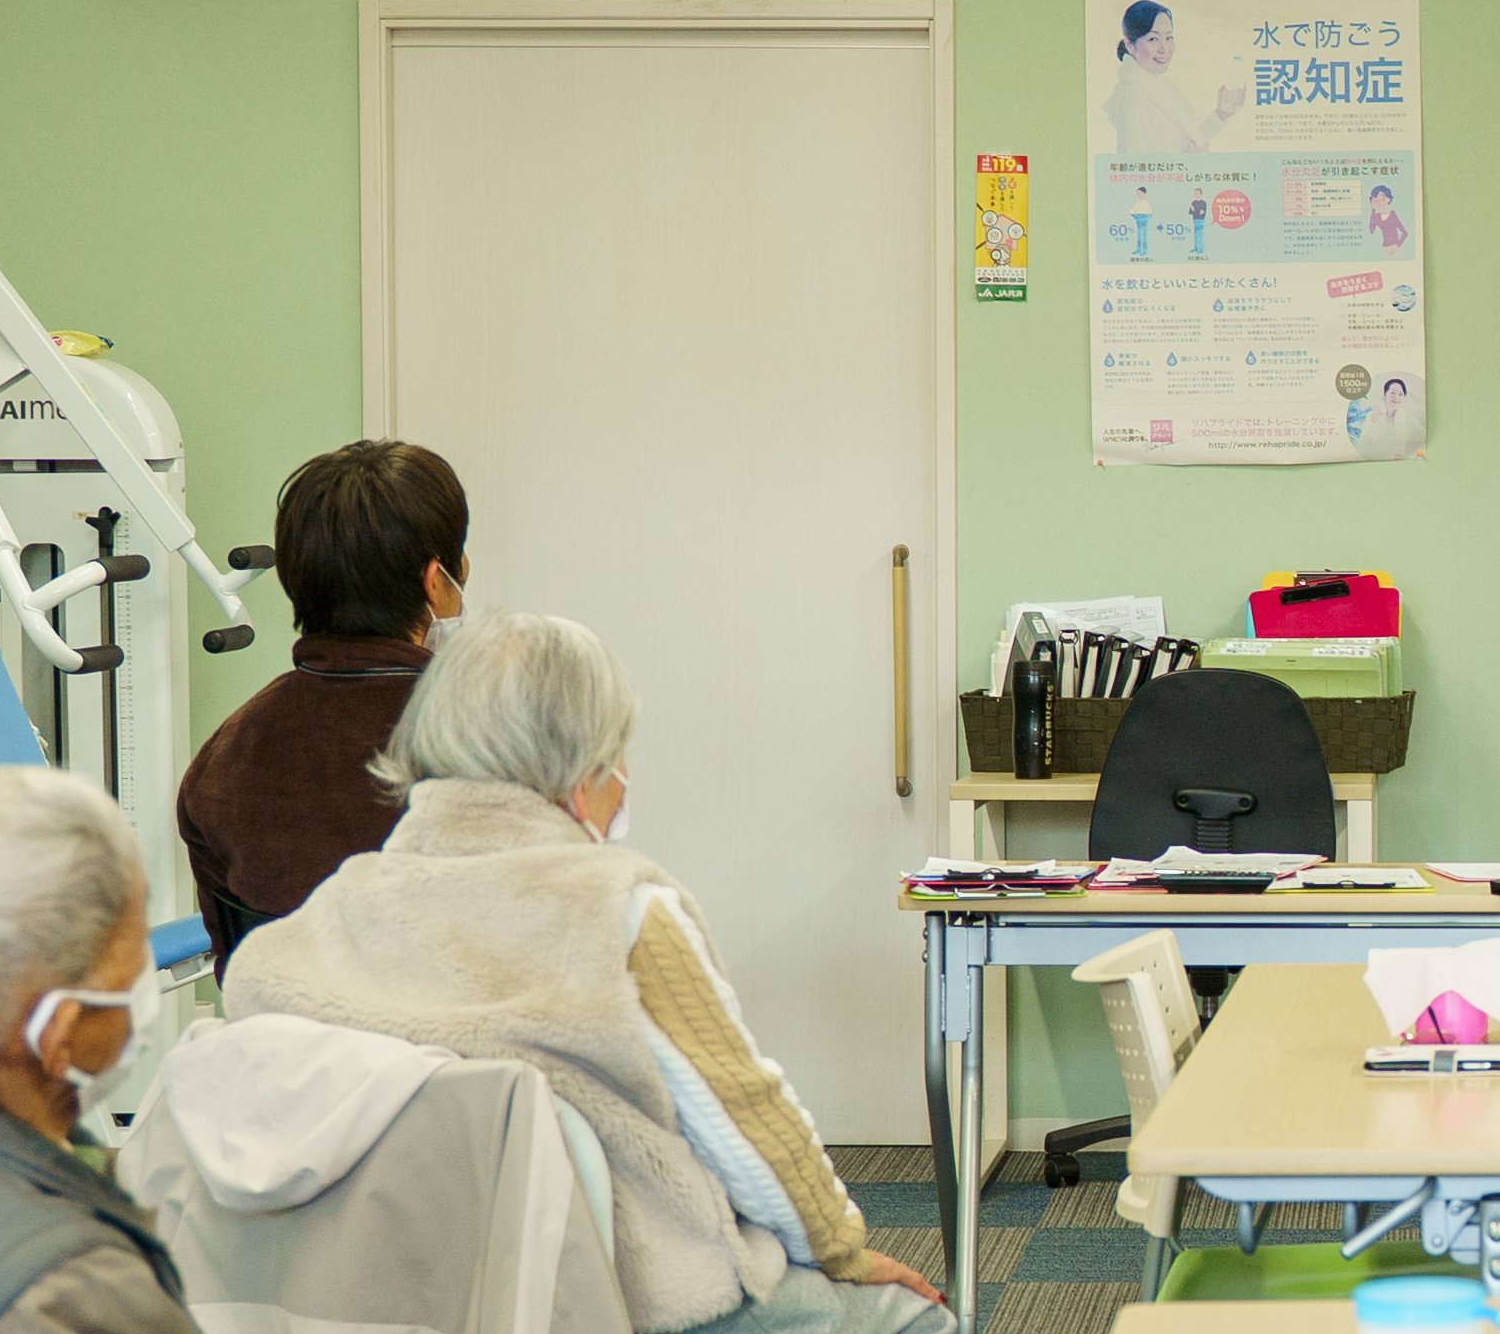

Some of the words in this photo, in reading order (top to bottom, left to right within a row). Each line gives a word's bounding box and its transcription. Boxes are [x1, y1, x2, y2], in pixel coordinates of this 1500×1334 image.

[1252, 20, 1401, 49] 水で防ごう
[1254, 57, 1404, 106] 認知症
[1101, 277, 1278, 291] 水を飲むといいことがたくさん!
[1044, 683, 1054, 766] STARBUCKS
